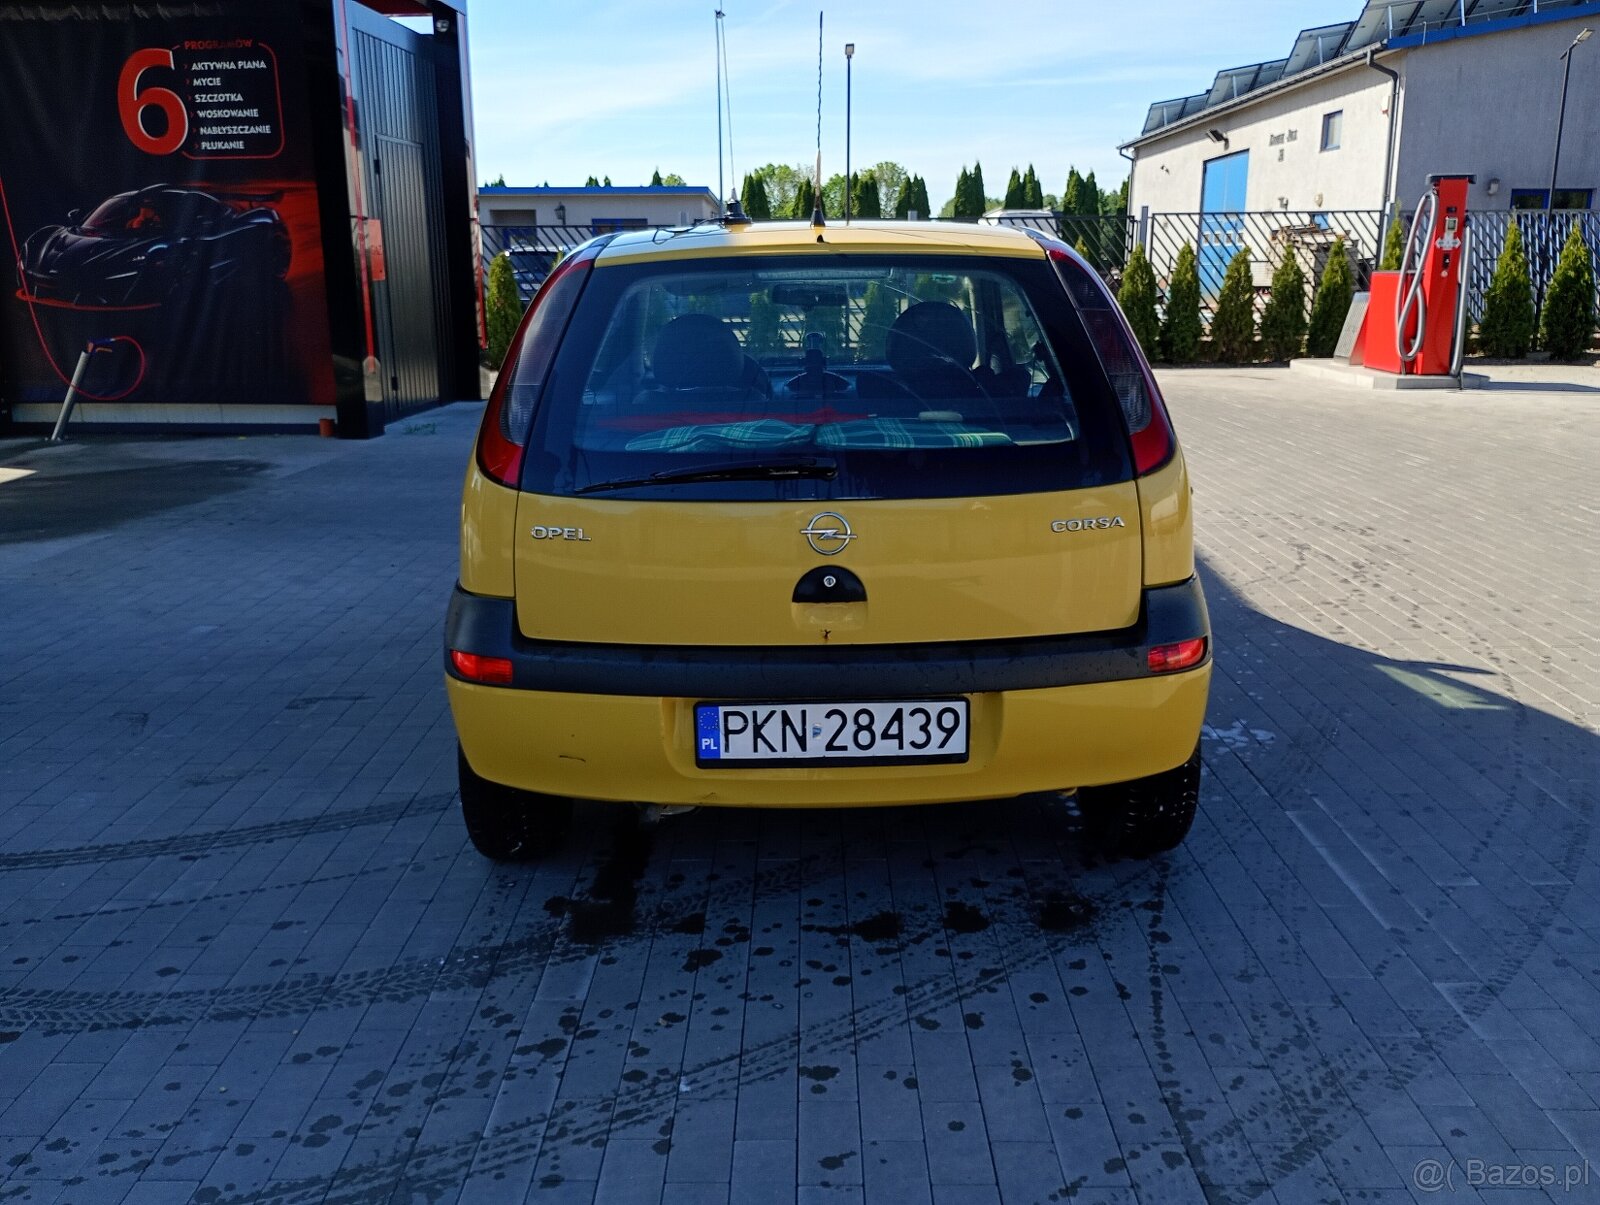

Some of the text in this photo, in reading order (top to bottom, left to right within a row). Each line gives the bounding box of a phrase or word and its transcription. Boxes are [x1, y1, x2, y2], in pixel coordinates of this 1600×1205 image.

[191, 60, 267, 71] AKTYWNA PIANA
[193, 77, 222, 86] MYCIE
[117, 47, 188, 155] 6
[195, 93, 244, 103] SZCZOTKA
[197, 109, 259, 118] WOSKOWANIE
[200, 125, 271, 134] NABŁYSZCZANIE
[201, 141, 245, 150] PŁUKANIE
[1051, 516, 1126, 533] CORSA
[531, 526, 592, 541] OPEL
[723, 707, 960, 753] PKN 28439
[701, 738, 718, 750] PL
